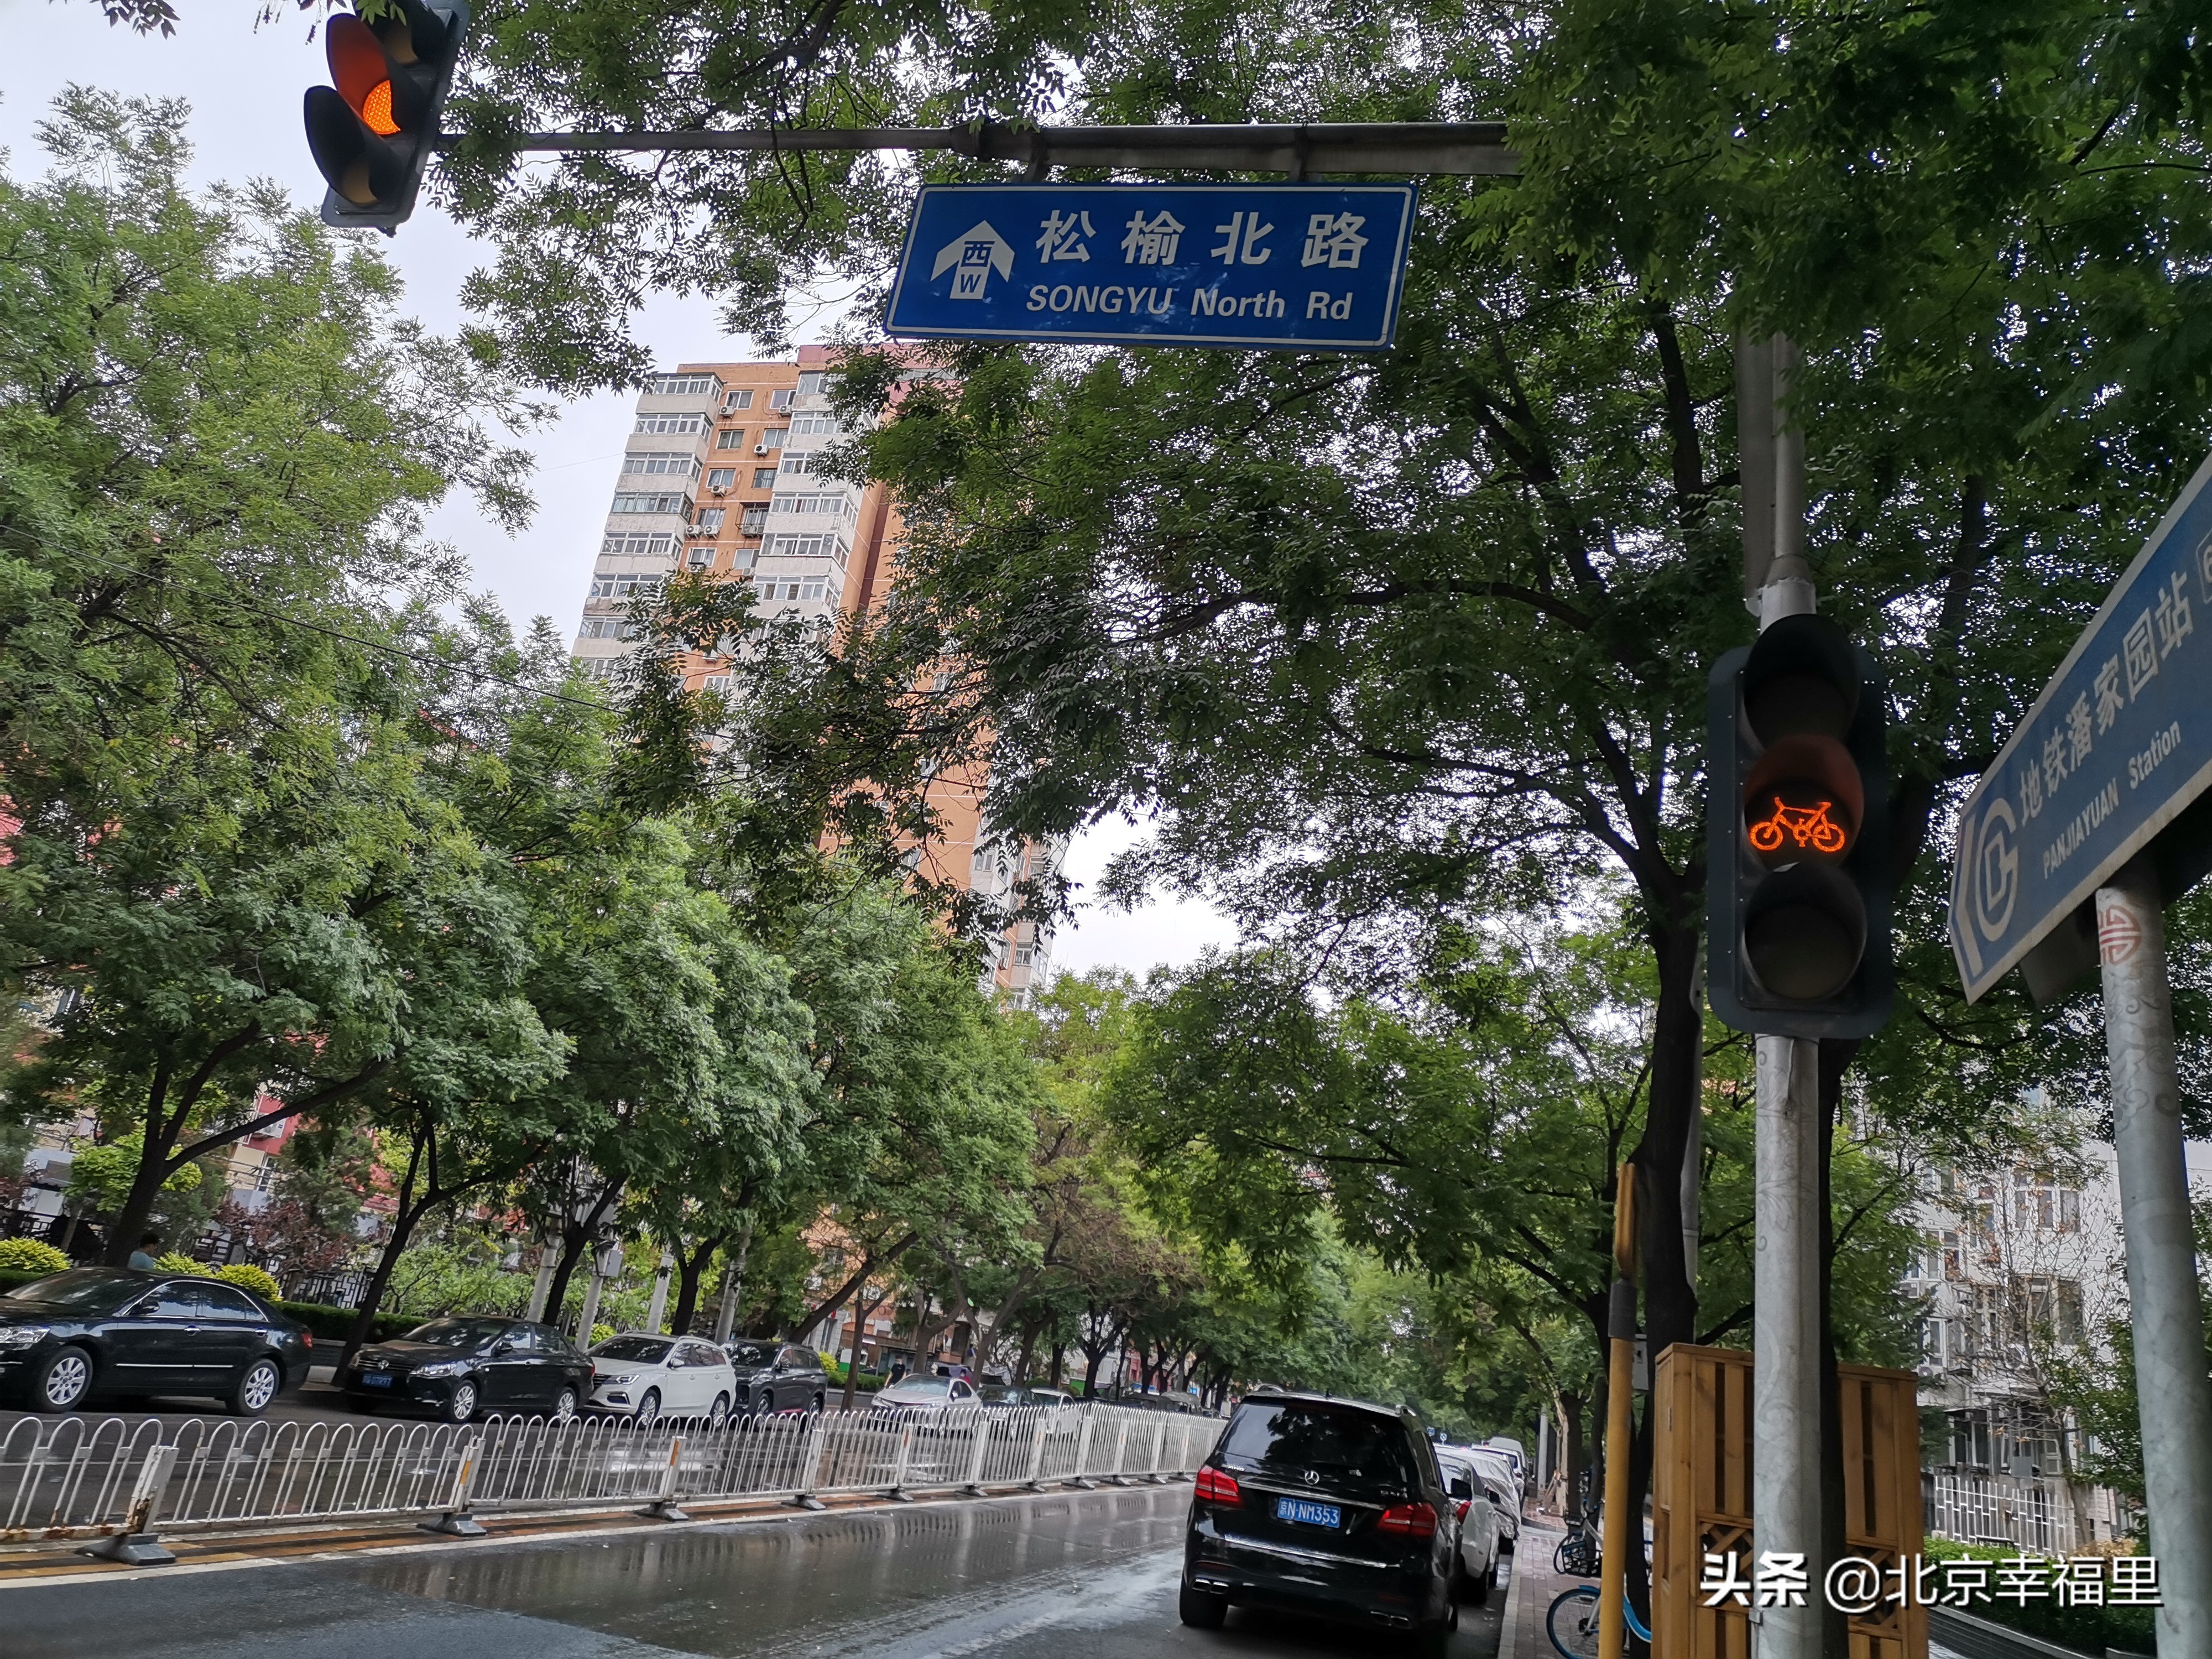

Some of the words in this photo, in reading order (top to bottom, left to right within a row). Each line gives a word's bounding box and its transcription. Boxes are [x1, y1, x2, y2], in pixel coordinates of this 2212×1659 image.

[961, 241, 995, 268] 西
[1036, 210, 1369, 269] 松榆北路
[960, 274, 982, 293] W
[1026, 285, 1173, 314] SONGYU
[1191, 289, 1285, 318] North
[1306, 291, 1353, 320] Rd
[2020, 570, 2194, 827] 地铁潘家园站
[2042, 778, 2120, 879] PANJIAYUAN
[2128, 720, 2181, 790] Station
